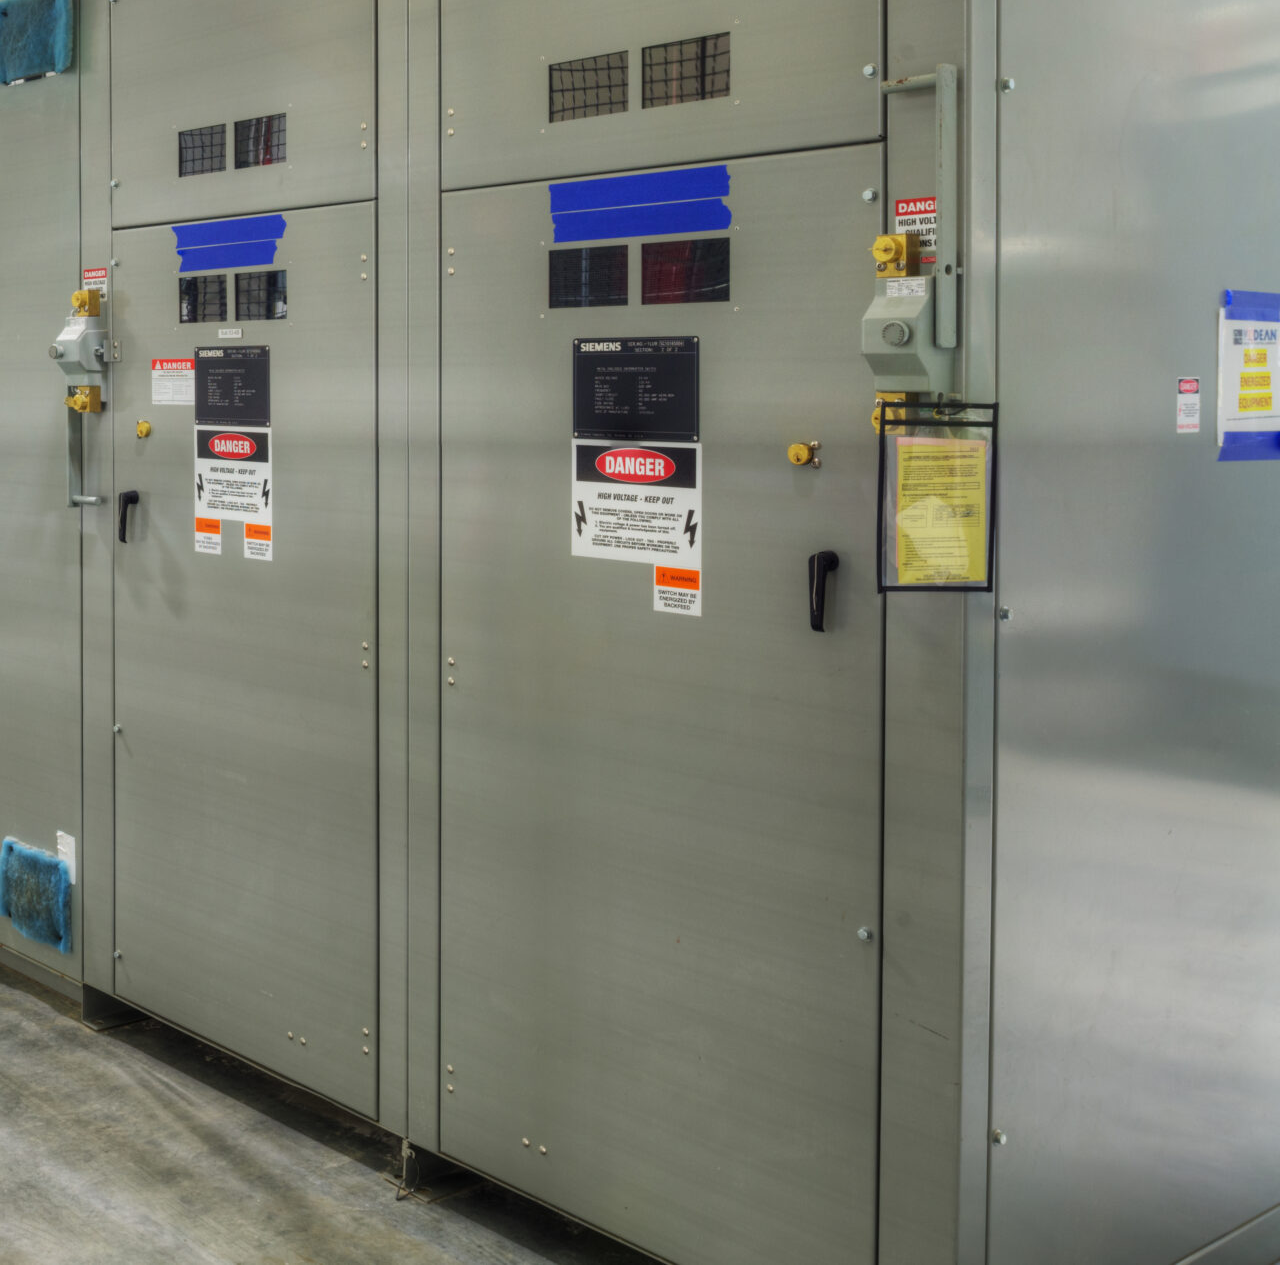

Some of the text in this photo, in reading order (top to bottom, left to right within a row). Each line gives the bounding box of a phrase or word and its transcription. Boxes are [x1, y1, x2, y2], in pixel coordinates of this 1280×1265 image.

[899, 218, 916, 226] HIGH
[580, 342, 622, 351] SIEMENS
[214, 439, 250, 454] DANGER
[605, 456, 664, 477] DANGER
[597, 492, 612, 500] HIGH
[613, 494, 638, 502] VOLTAGE
[662, 497, 674, 505] OUT
[670, 575, 697, 583] WARNING
[664, 602, 690, 610] BACKFEED
